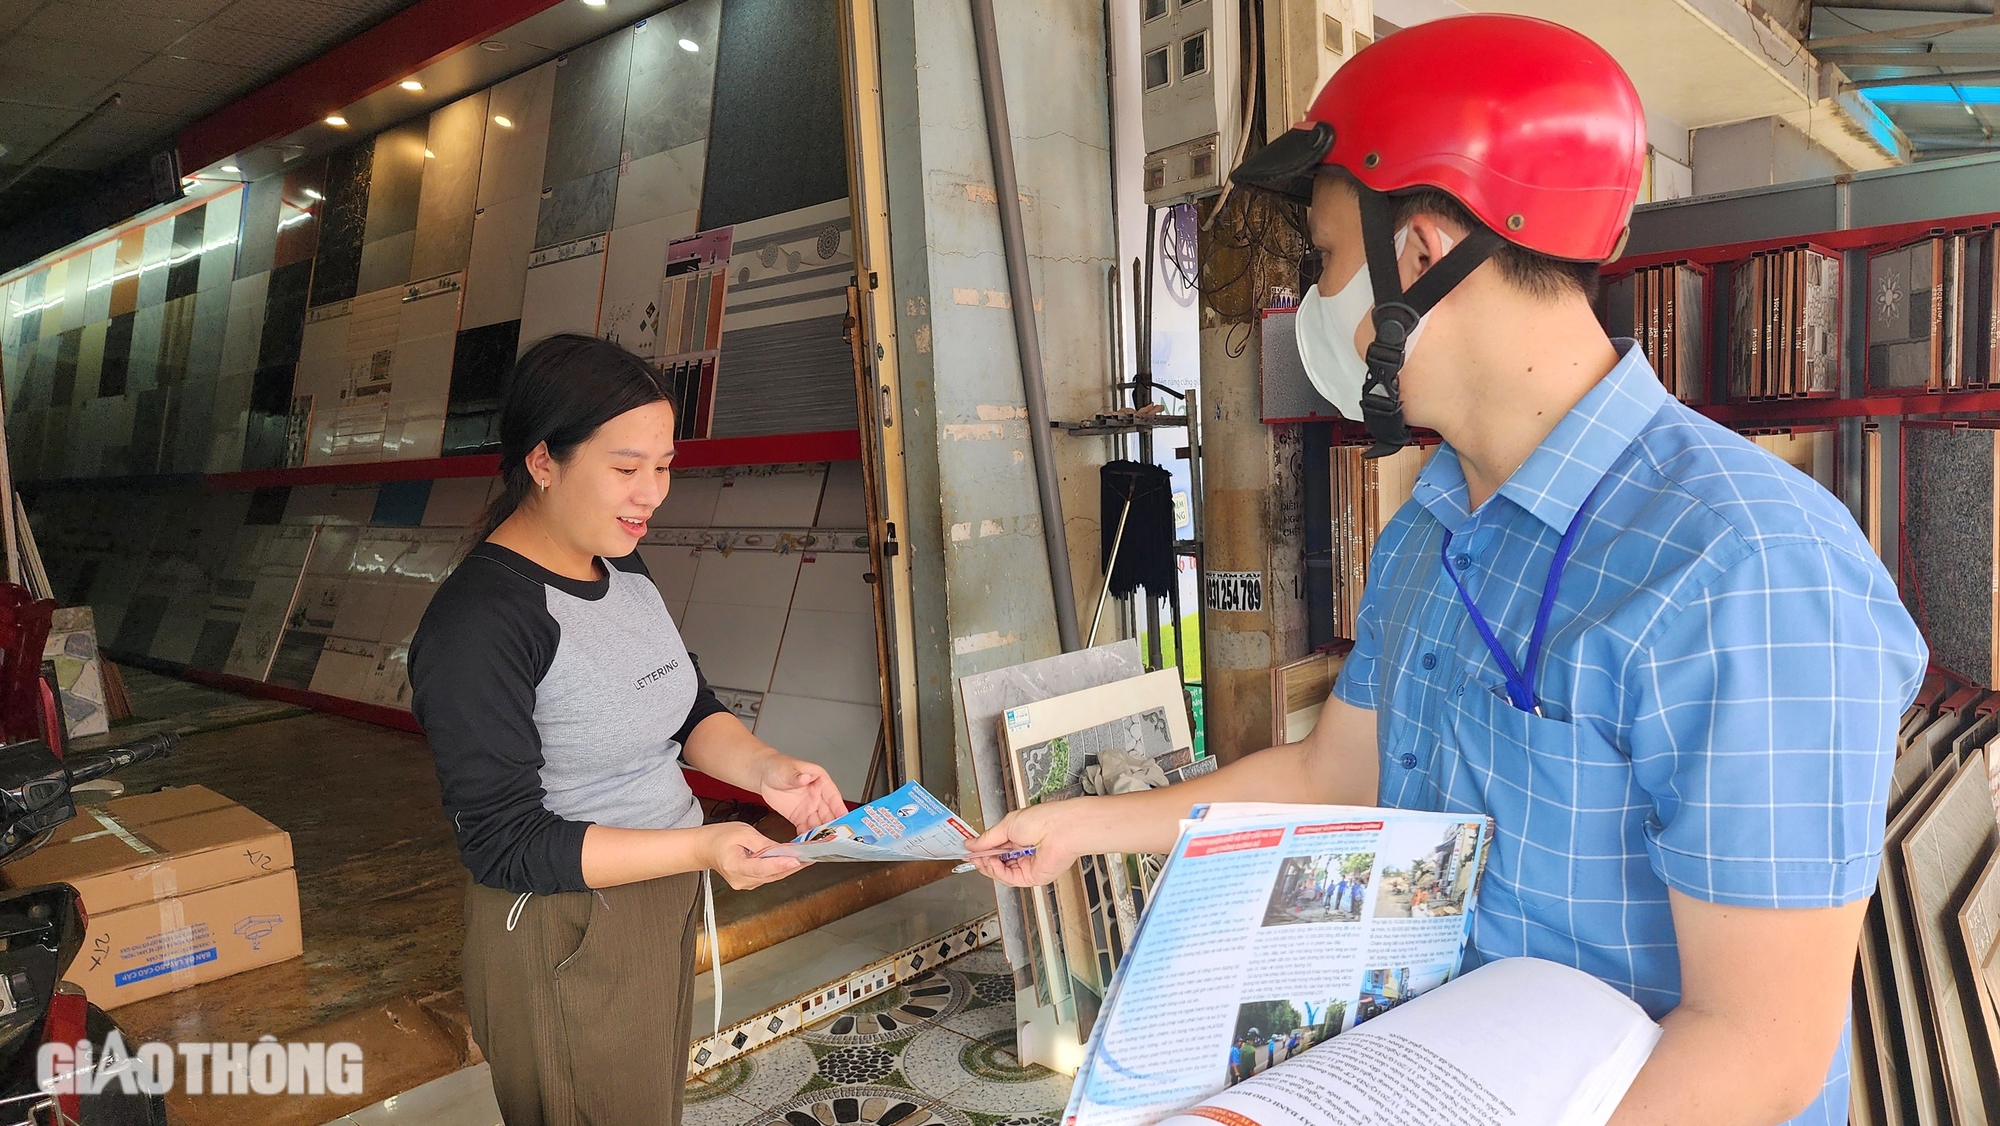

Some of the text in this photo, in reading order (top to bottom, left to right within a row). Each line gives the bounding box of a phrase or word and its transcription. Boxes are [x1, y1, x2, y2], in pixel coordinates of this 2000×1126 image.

[632, 660, 679, 690] LETTERING
[138, 965, 154, 976] CAO
[1401, 1054, 1418, 1065] sung
[1438, 1056, 1448, 1065] đã
[1326, 1072, 1342, 1081] toàn
[1342, 1078, 1352, 1086] an
[1416, 1074, 1426, 1082] số
[1378, 1078, 1394, 1092] sung
[1426, 1080, 1441, 1092] định
[1441, 1079, 1453, 1090] sửa
[1469, 1078, 1484, 1090] Quy
[1326, 1090, 1341, 1100] một
[1352, 1084, 1367, 1096] lang
[1483, 1088, 1498, 1102] theo
[1252, 1093, 1272, 1102] CHO
[1368, 1094, 1384, 1108] hành
[1442, 1092, 1459, 1108] Nghị
[1343, 1100, 1360, 1114] sung
[1420, 1098, 1436, 1112] đoạn
[1486, 1102, 1500, 1115] Đối
[1499, 1100, 1516, 1116] dụng
[1384, 1107, 1394, 1115] có
[1401, 1108, 1410, 1116] số
[1438, 1112, 1449, 1122] các
